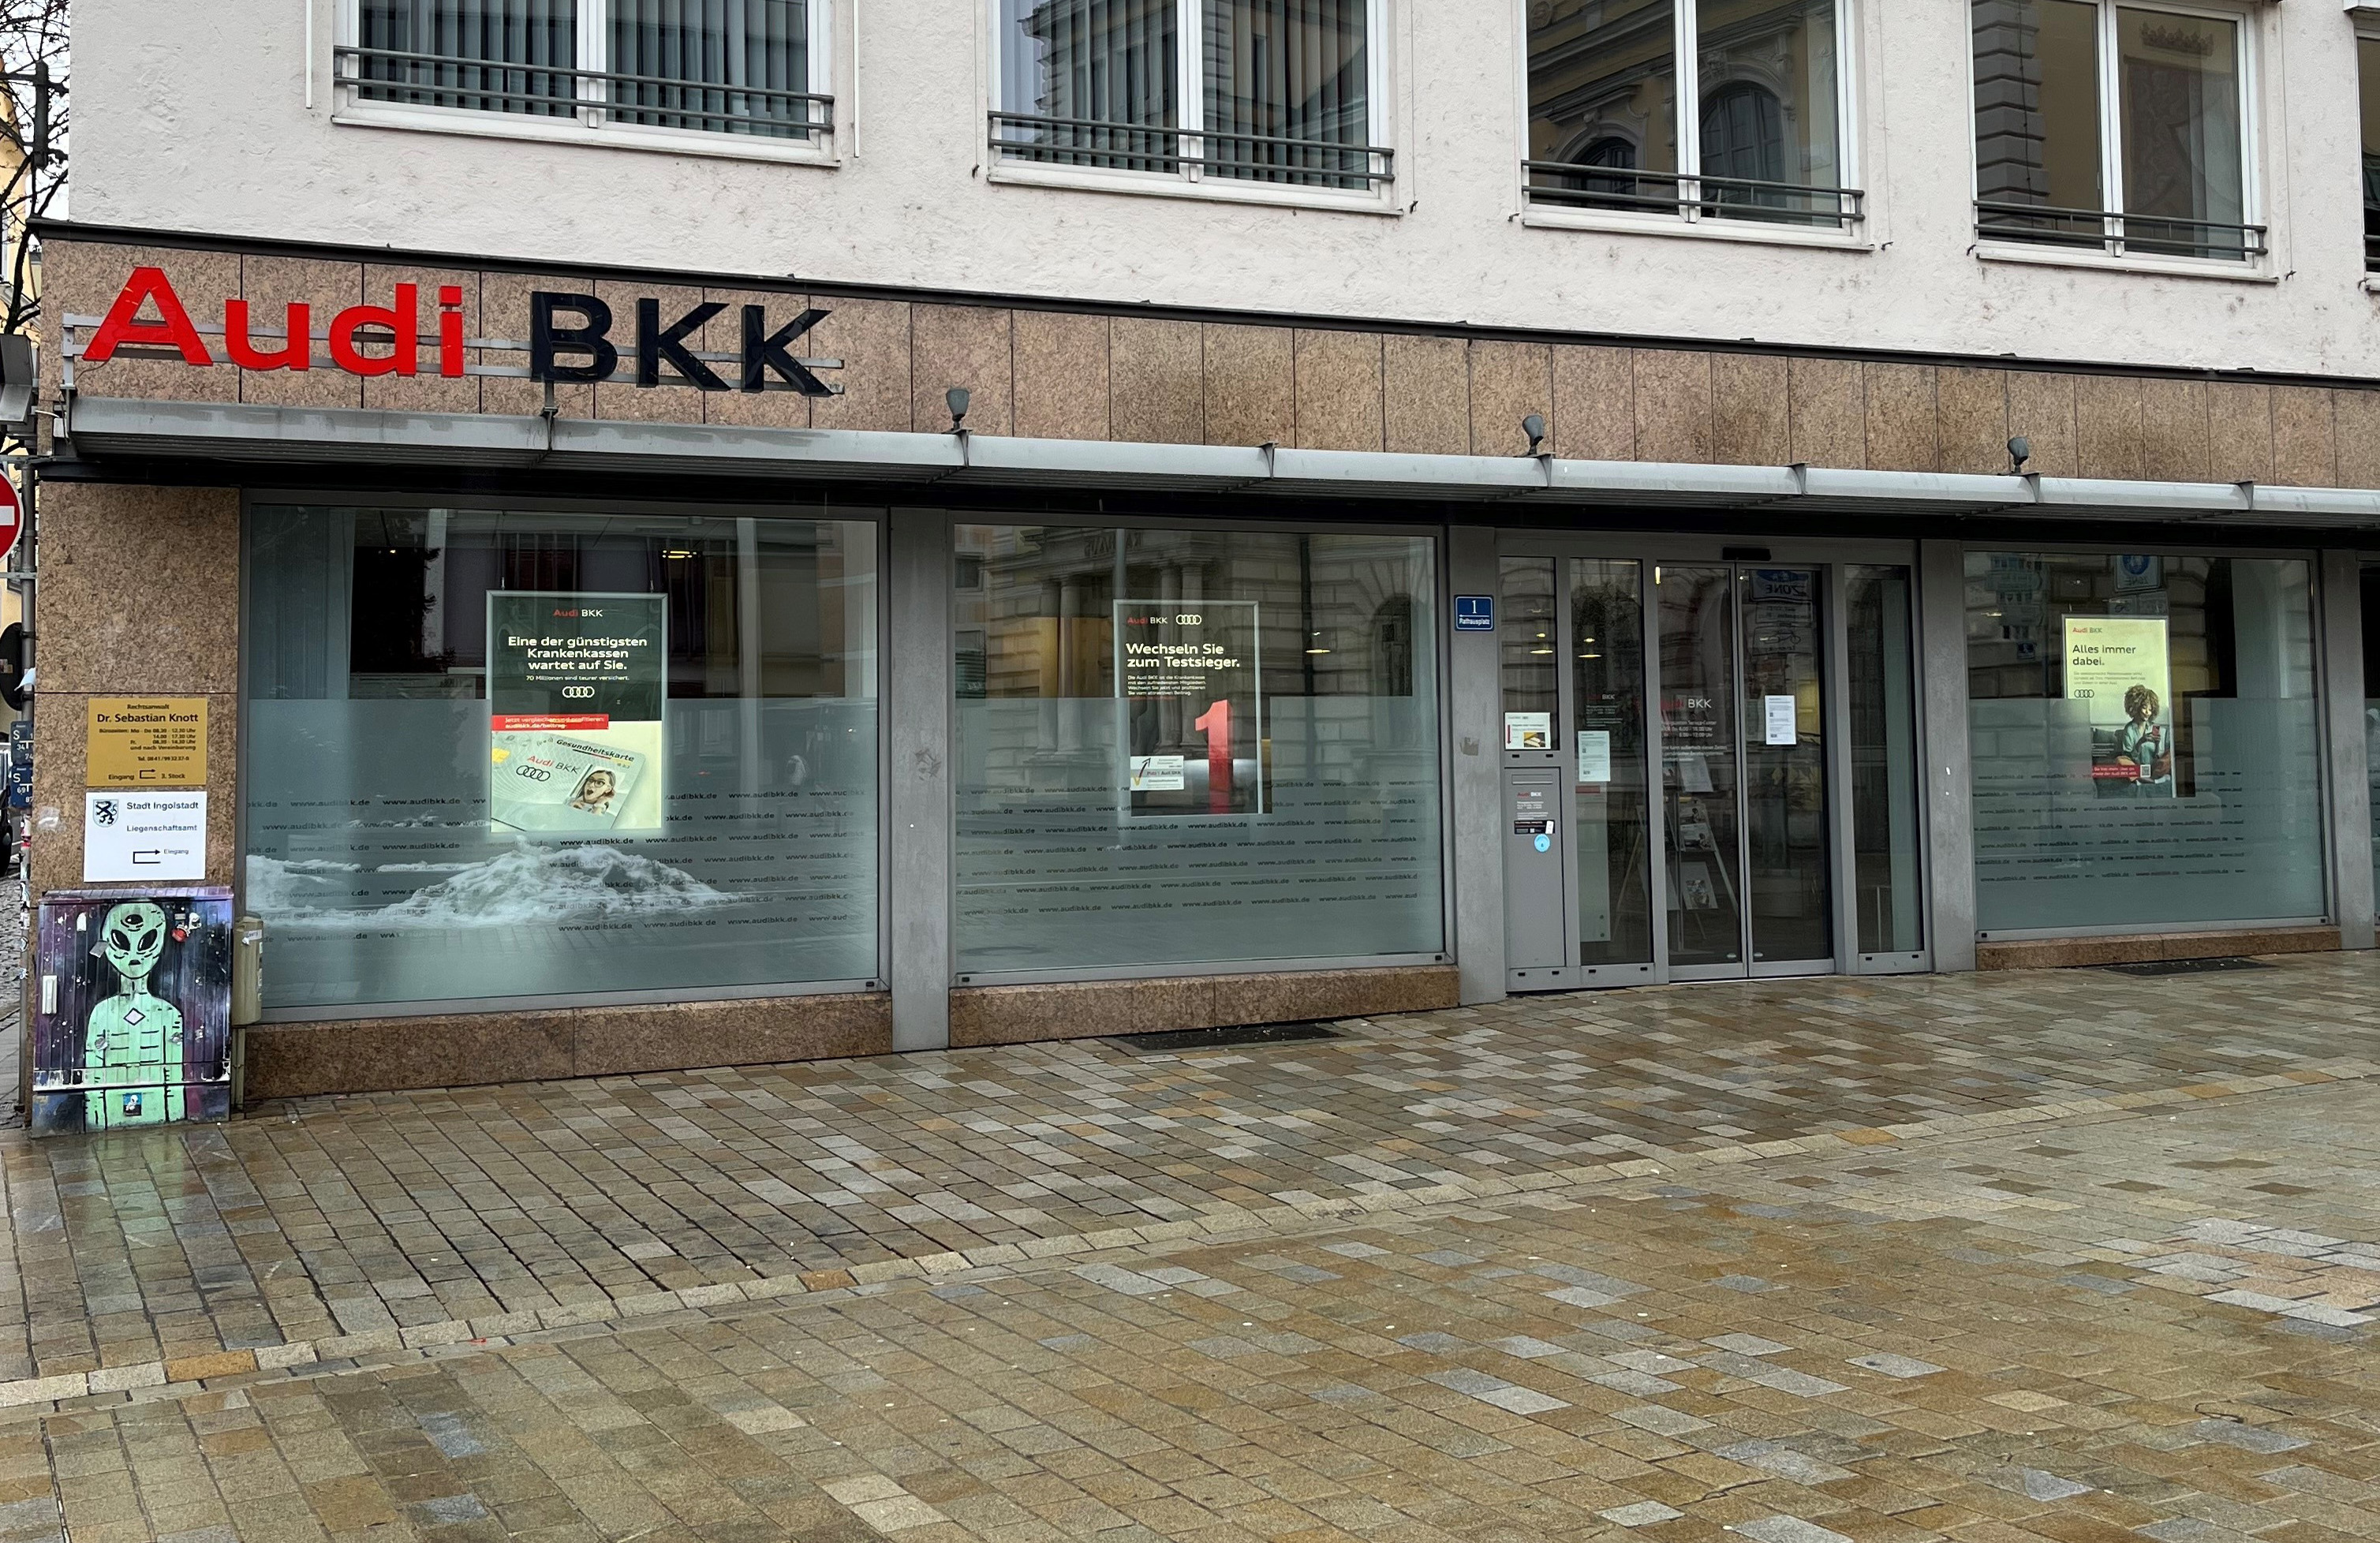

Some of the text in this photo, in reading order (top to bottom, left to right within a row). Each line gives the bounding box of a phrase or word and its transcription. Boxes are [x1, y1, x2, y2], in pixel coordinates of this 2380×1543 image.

[82, 267, 833, 397] Audi BKK
[1472, 600, 1477, 614] 1
[508, 637, 648, 648] Eine der günstigsten
[528, 648, 629, 658] Krankenkassen
[1126, 643, 1224, 654] Wechseln Sie
[2072, 644, 2136, 654] Alles immer
[528, 660, 627, 670] wartet auf Sie.
[1127, 656, 1240, 670] zum Testsieger.
[2072, 656, 2105, 666] dabei.
[1688, 699, 1712, 708] BKK
[97, 713, 199, 723] Dr. Sebastian Knott
[13, 730, 21, 740] S
[556, 739, 635, 762] Gesundheitskarte
[1195, 699, 1233, 814] 1
[528, 755, 581, 775] Audi BKK
[13, 773, 21, 783] S
[153, 801, 199, 811] Ingolstadt
[727, 916, 798, 925] www.audibkk.de
